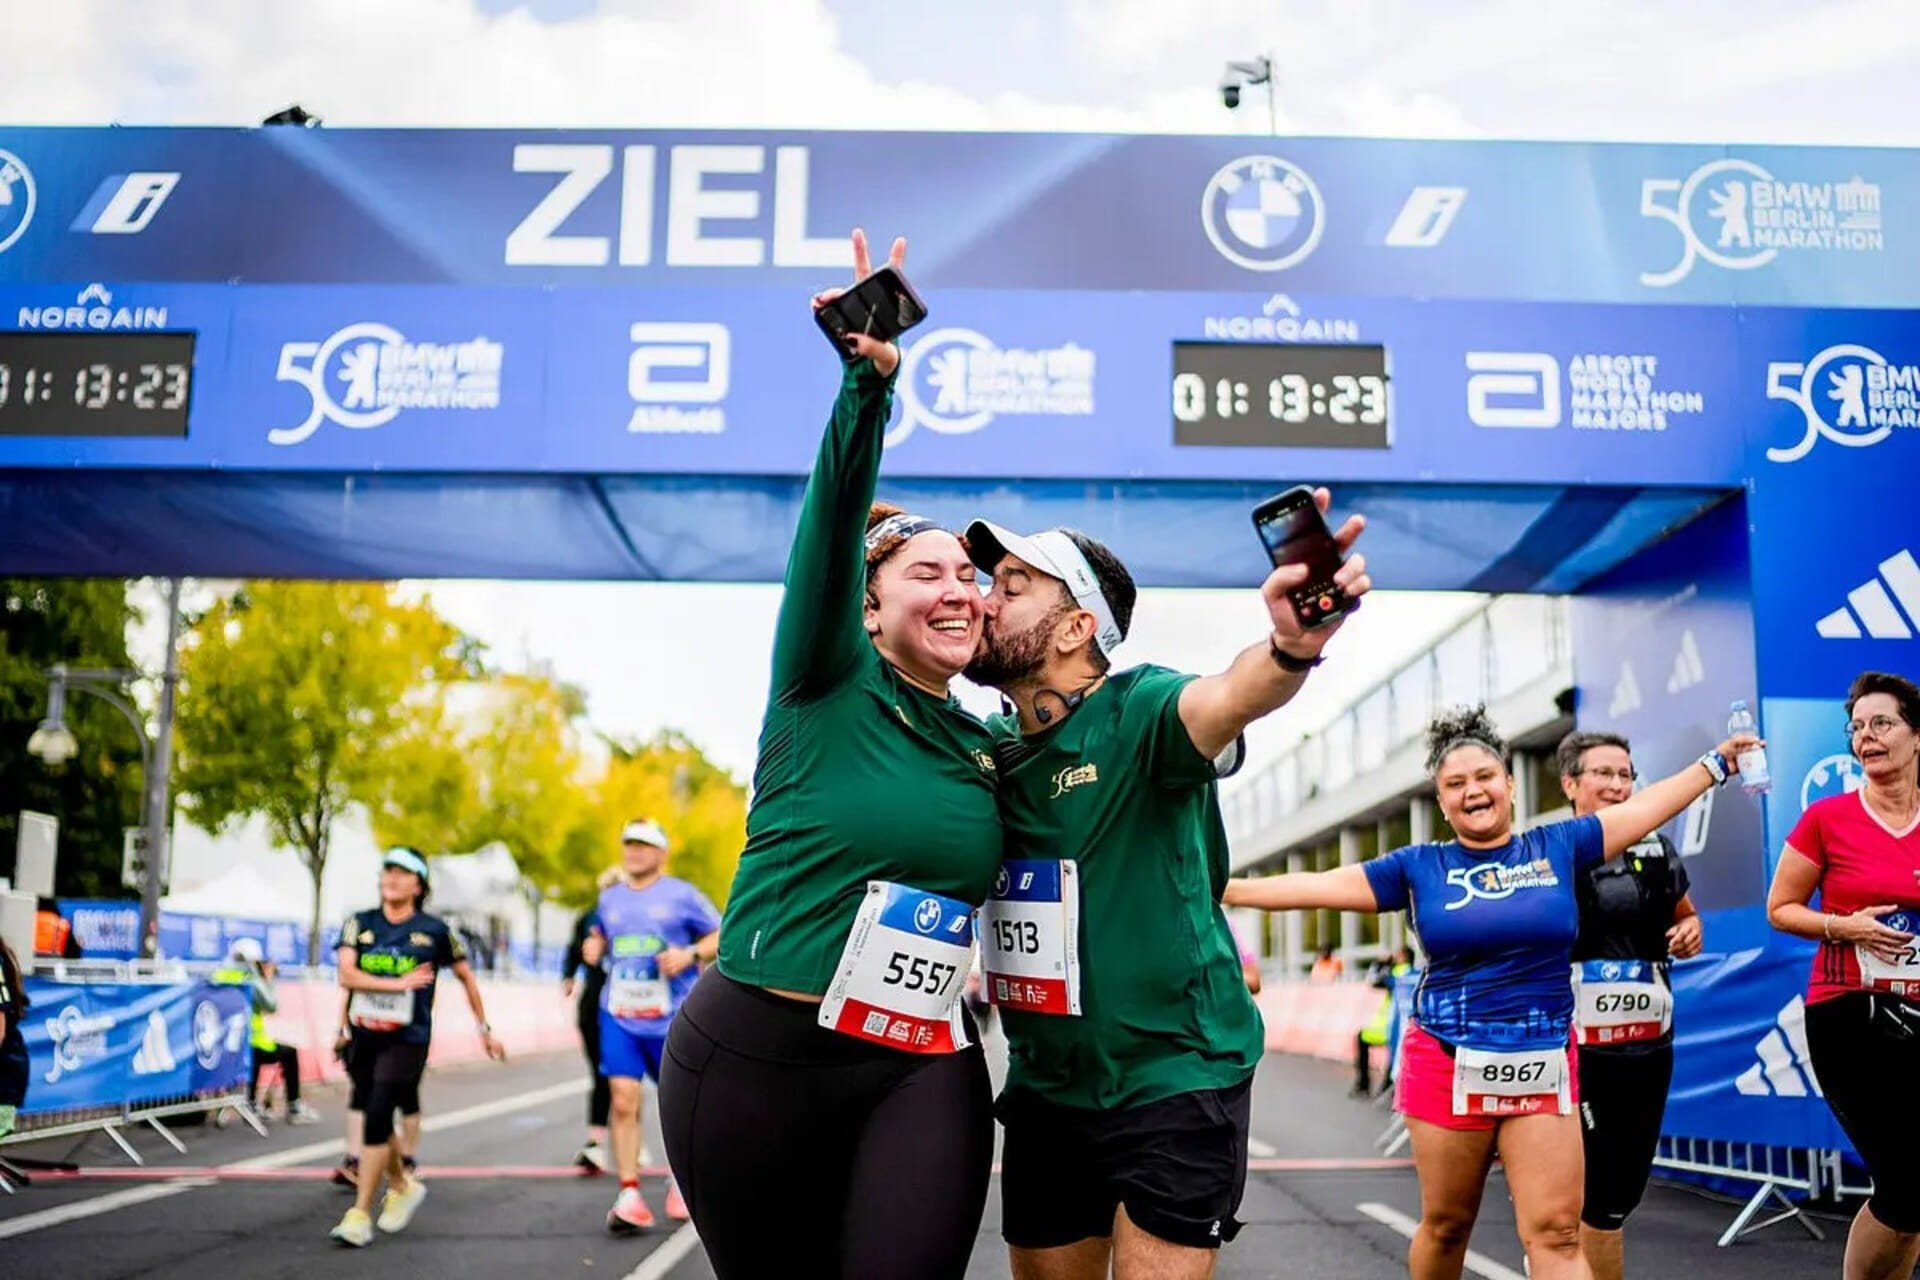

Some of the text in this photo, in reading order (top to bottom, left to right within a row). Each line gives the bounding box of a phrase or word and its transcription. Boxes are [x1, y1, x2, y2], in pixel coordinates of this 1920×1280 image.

[505, 144, 857, 267] ZIEL
[1751, 180, 1834, 209] BMW
[1752, 208, 1836, 229] BERLIN
[1753, 229, 1884, 251] MARATHON
[1569, 355, 1657, 377] ABBOTT
[75, 364, 188, 410] 13:23
[1268, 374, 1386, 424] 13:23
[1571, 391, 1704, 412] MARATHON
[1572, 409, 1667, 430] MAJORS
[992, 920, 1039, 954] 1513
[882, 951, 957, 997] 5557
[1595, 993, 1650, 1013] 6790
[1482, 1061, 1546, 1082] 8967
